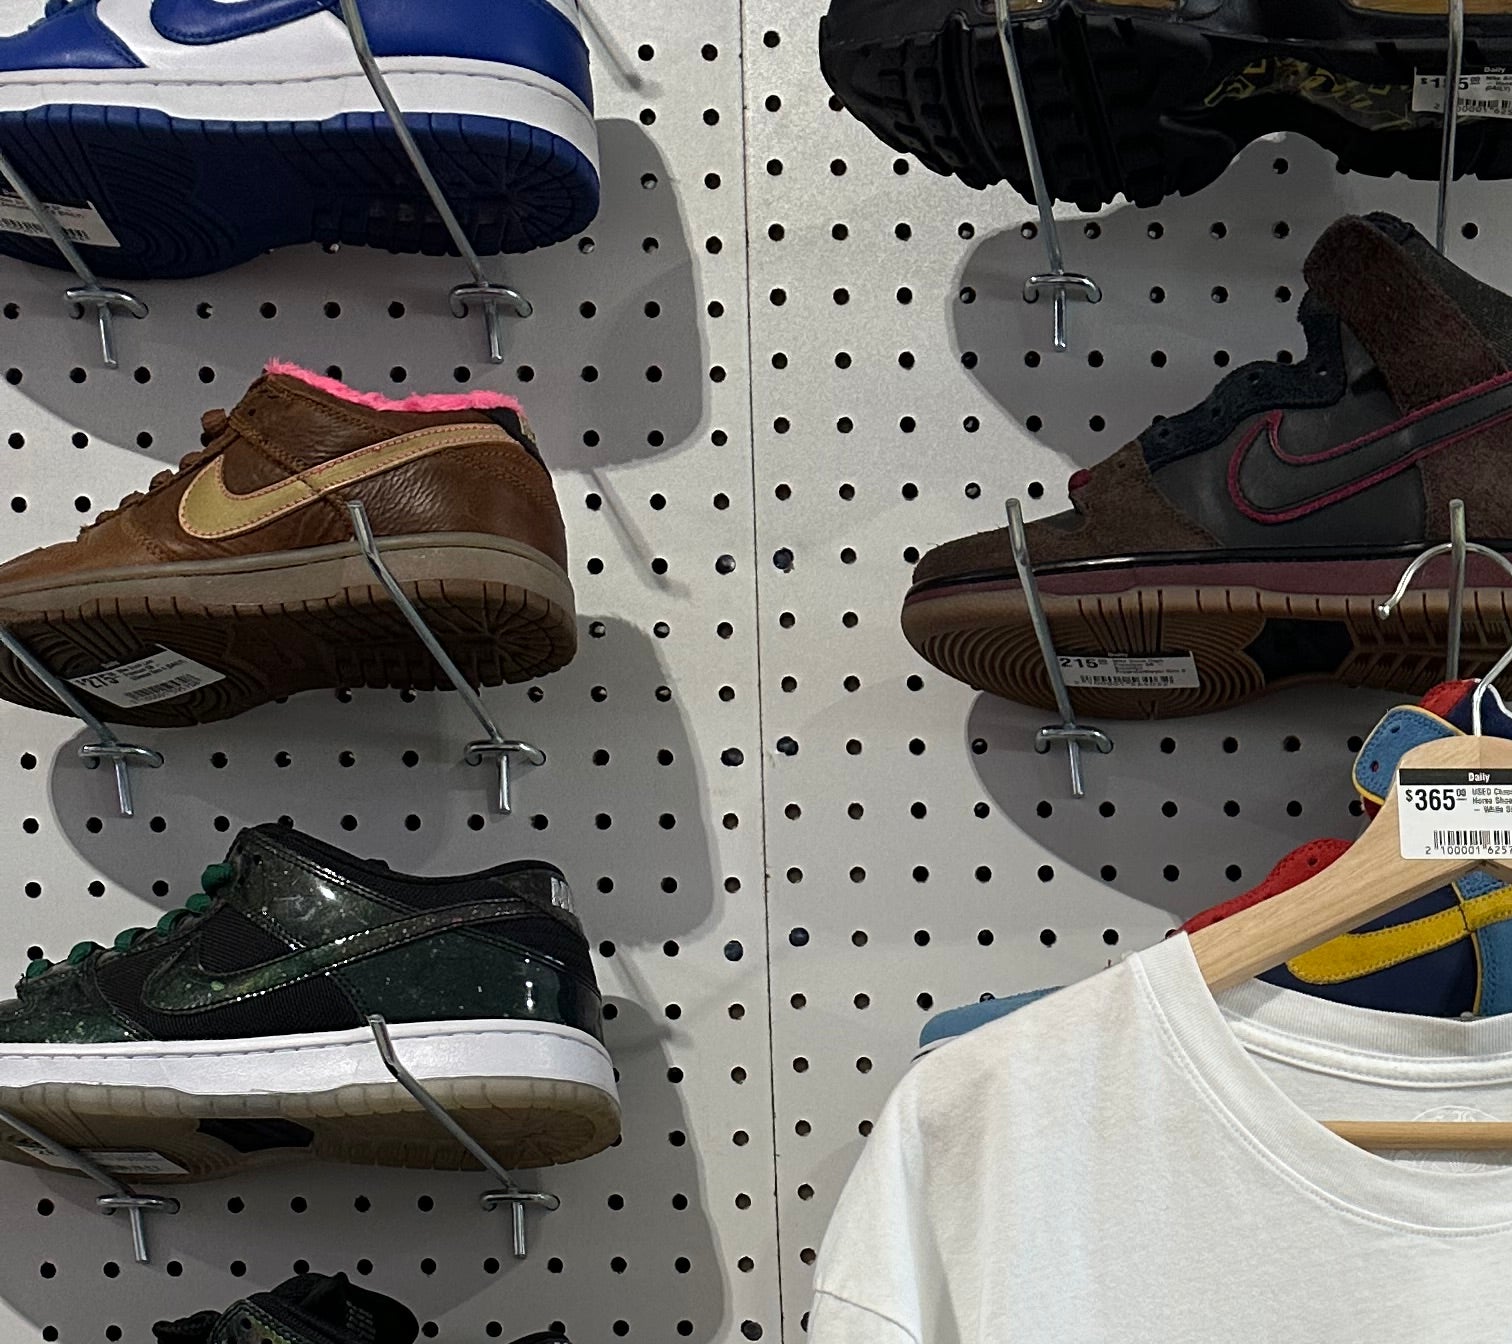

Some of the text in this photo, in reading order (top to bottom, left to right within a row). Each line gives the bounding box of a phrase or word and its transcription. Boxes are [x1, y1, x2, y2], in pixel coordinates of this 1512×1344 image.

[1420, 77, 1469, 90] $15
[1468, 772, 1490, 784] Daily
[1405, 788, 1456, 812] $365
